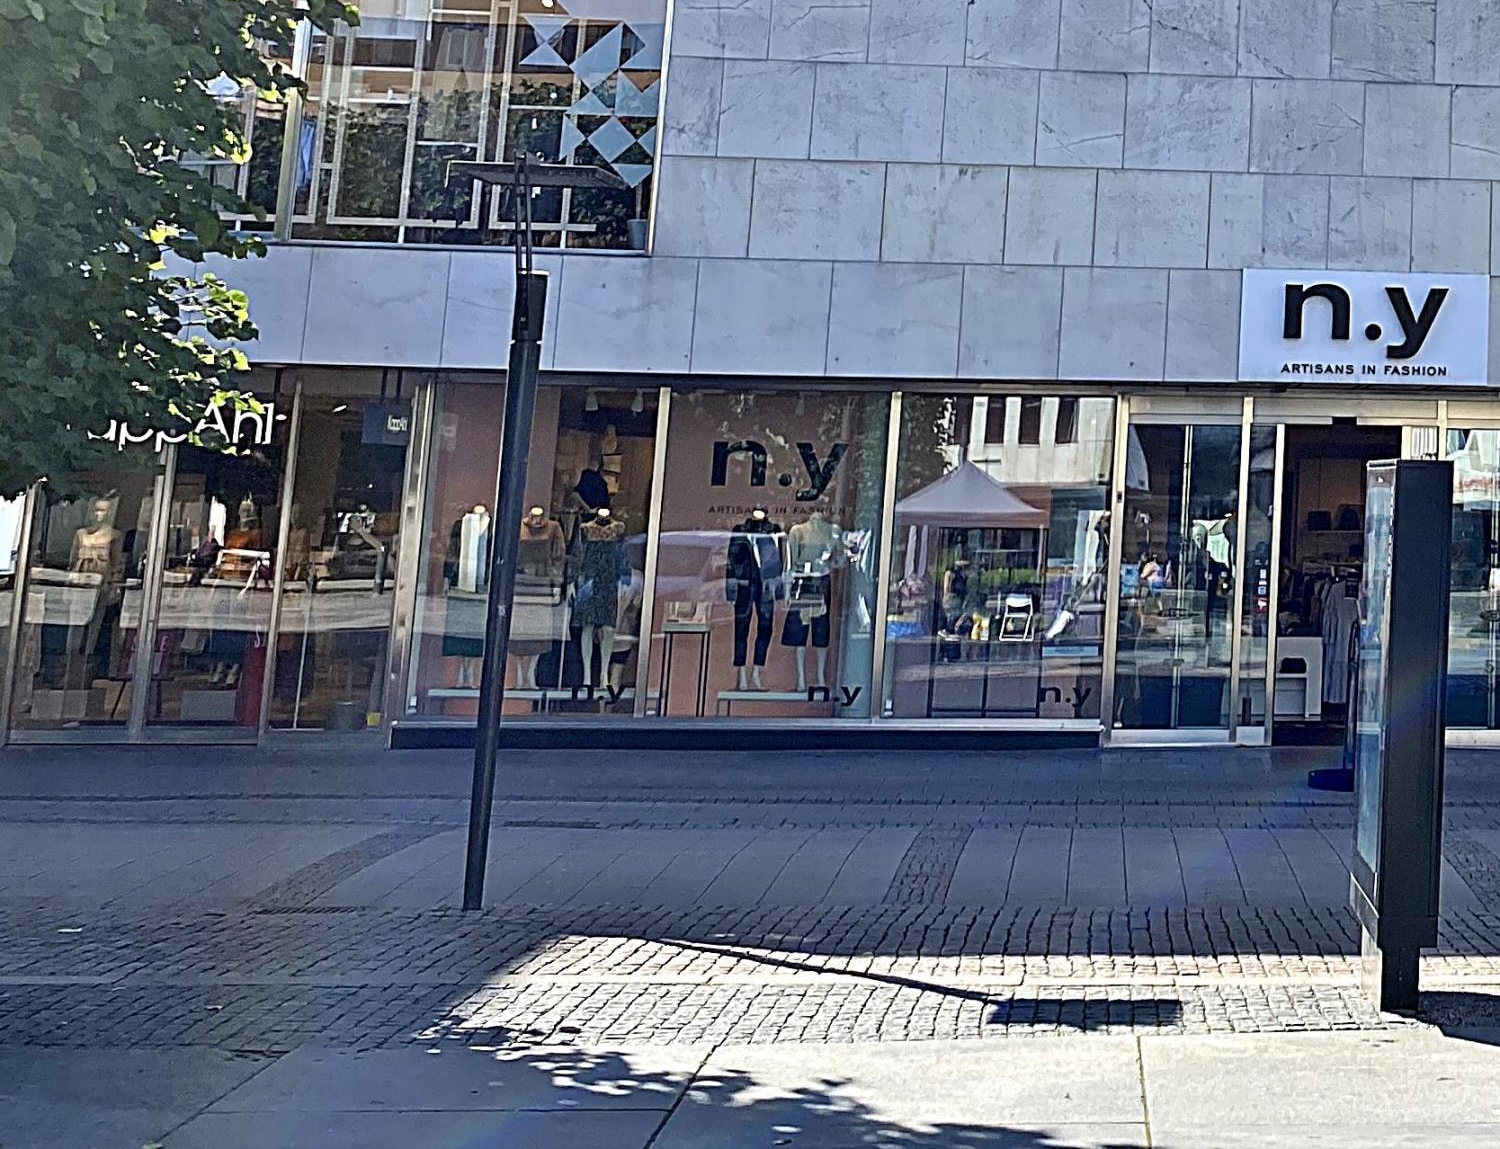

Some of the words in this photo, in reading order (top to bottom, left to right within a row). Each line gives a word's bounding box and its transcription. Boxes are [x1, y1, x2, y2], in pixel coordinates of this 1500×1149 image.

[1283, 283, 1450, 359] n.y
[1280, 362, 1355, 375] ARTISANS
[1361, 364, 1377, 376] IN
[1384, 365, 1448, 377] FASHION
[710, 439, 850, 502] n.y
[807, 684, 863, 707] n.y
